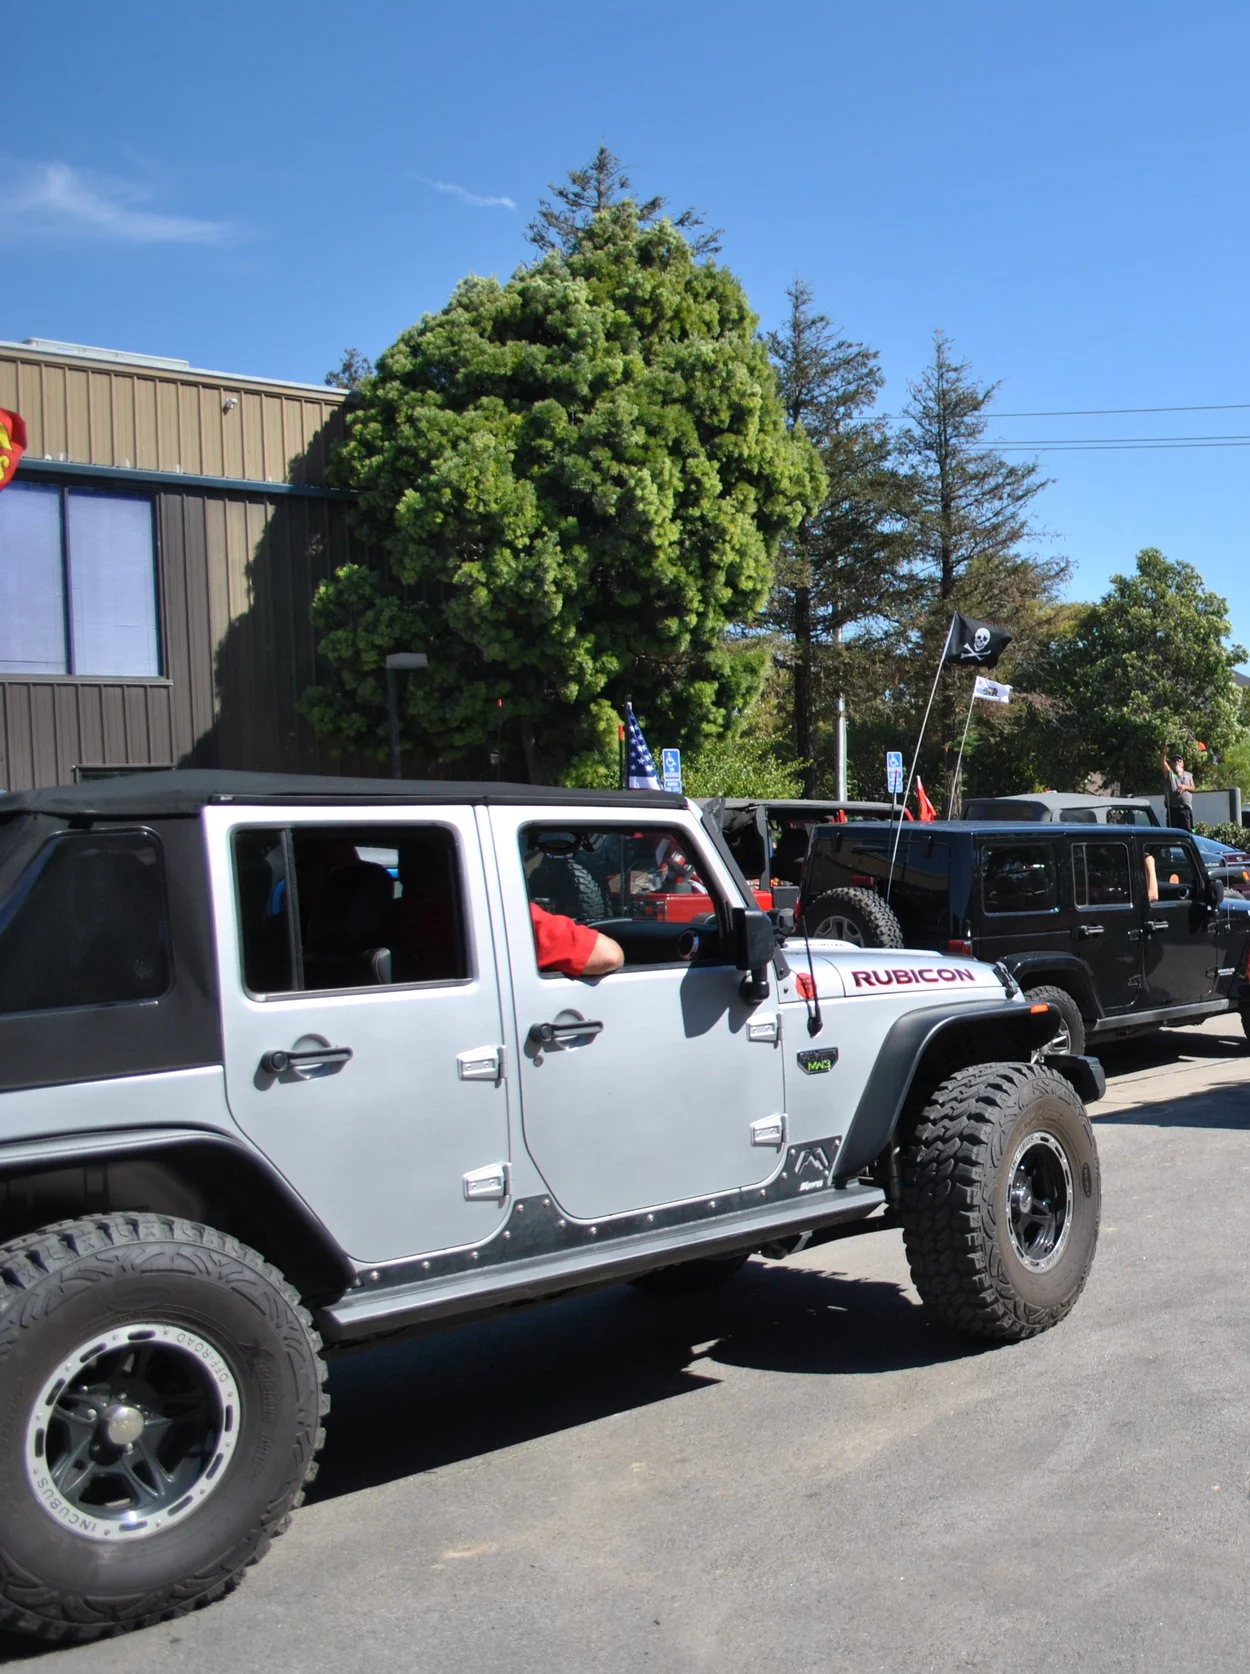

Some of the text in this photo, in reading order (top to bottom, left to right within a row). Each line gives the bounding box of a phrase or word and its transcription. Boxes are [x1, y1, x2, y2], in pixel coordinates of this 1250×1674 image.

[851, 968, 976, 988] RUBICON
[176, 1332, 229, 1384] OFF-ROAD
[36, 1476, 97, 1533] INCUBUS
